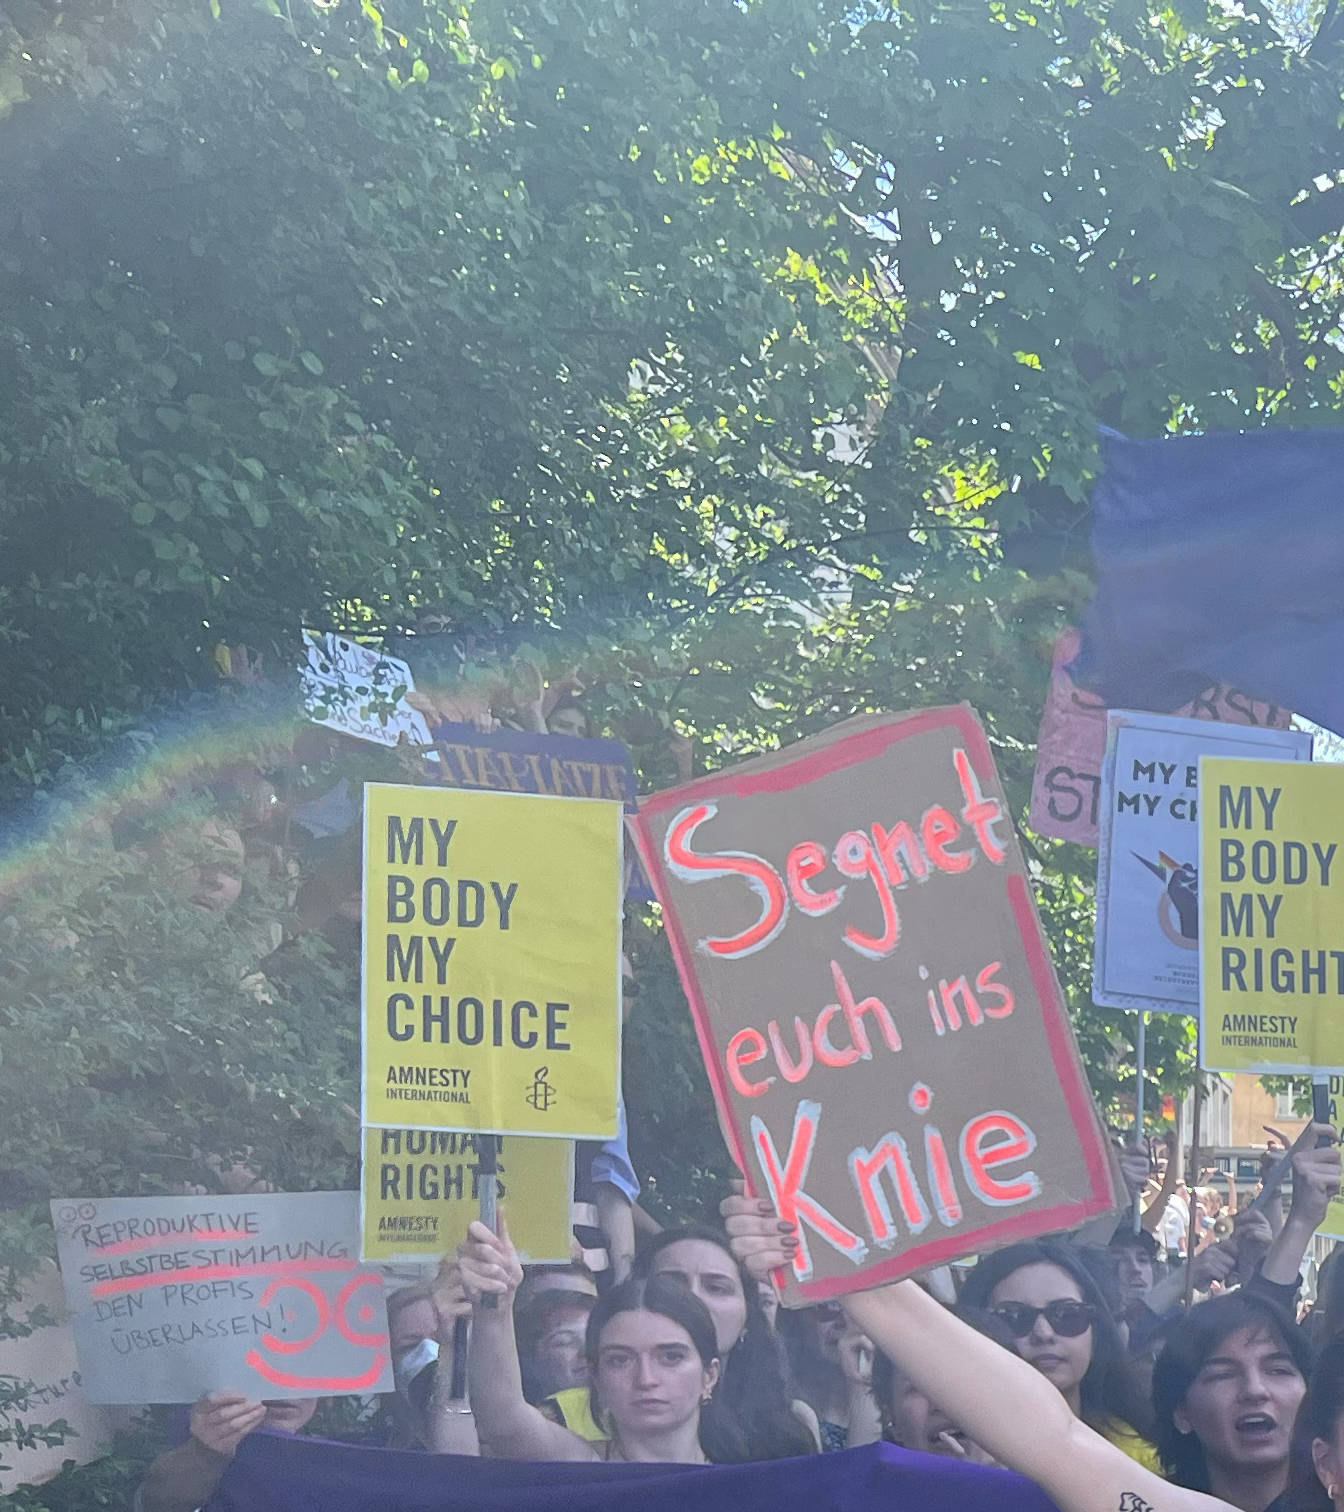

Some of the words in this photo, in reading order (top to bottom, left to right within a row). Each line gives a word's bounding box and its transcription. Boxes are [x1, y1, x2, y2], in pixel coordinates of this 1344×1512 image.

[1133, 759, 1177, 785] MY
[1117, 791, 1162, 816] MY
[1219, 784, 1282, 831] MY
[386, 815, 457, 867] MY
[665, 748, 1006, 959] Segnet
[1219, 839, 1338, 887] BODY
[386, 874, 519, 930] BODY
[1220, 892, 1283, 939] MY
[386, 934, 456, 985] MY
[386, 993, 571, 1050] CHOICE
[726, 959, 902, 1098] euch
[917, 961, 1016, 1036] ins
[1221, 1014, 1298, 1034] AMNESTY
[1221, 1035, 1298, 1048] INTERNATIONAL
[386, 1066, 472, 1089] AMNESTY
[386, 1088, 472, 1105] INTERNATIONAL
[380, 1129, 504, 1154] HUMA
[750, 1081, 1042, 1282] Knie
[79, 1212, 261, 1248] REPRODUKTIVE
[79, 1241, 350, 1284] SELBSTBESTIMMUNG
[92, 1291, 144, 1323] DEN
[161, 1280, 255, 1306] PROFIS
